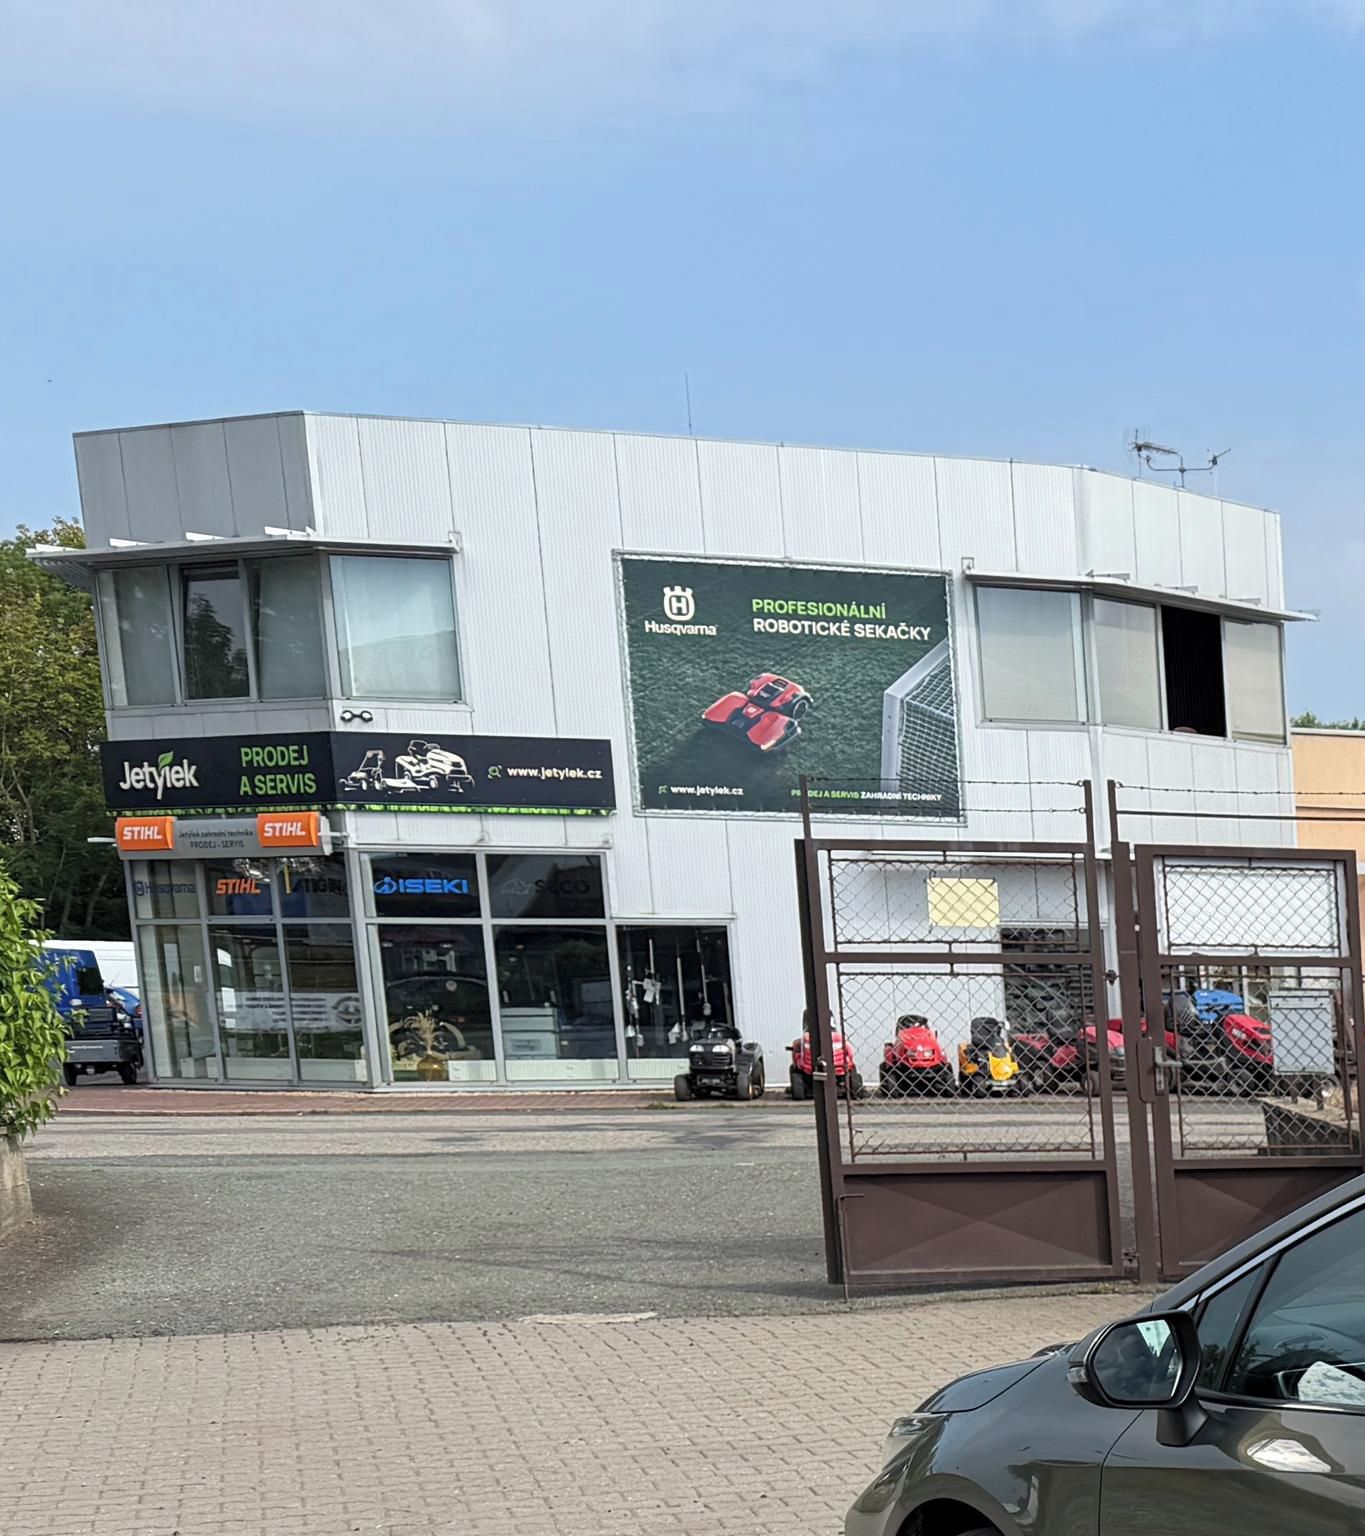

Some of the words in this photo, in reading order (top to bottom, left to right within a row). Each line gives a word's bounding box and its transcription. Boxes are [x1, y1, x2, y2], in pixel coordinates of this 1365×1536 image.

[752, 598, 886, 619] PROFESIONÁLNÍ
[644, 620, 717, 637] Husqvarna
[753, 618, 851, 637] ROBOTICKÉ
[853, 622, 931, 640] SEKAČKY
[239, 744, 309, 768] PRODEJ
[506, 765, 602, 782] www.jetylek.cz
[239, 775, 253, 796] A
[254, 772, 317, 795] SERVIS
[670, 784, 744, 797] www.jetylek.cz
[123, 826, 163, 840] STIHL
[263, 821, 306, 837] STIHL
[215, 878, 262, 895] STIHL
[399, 878, 470, 894] ISEKI
